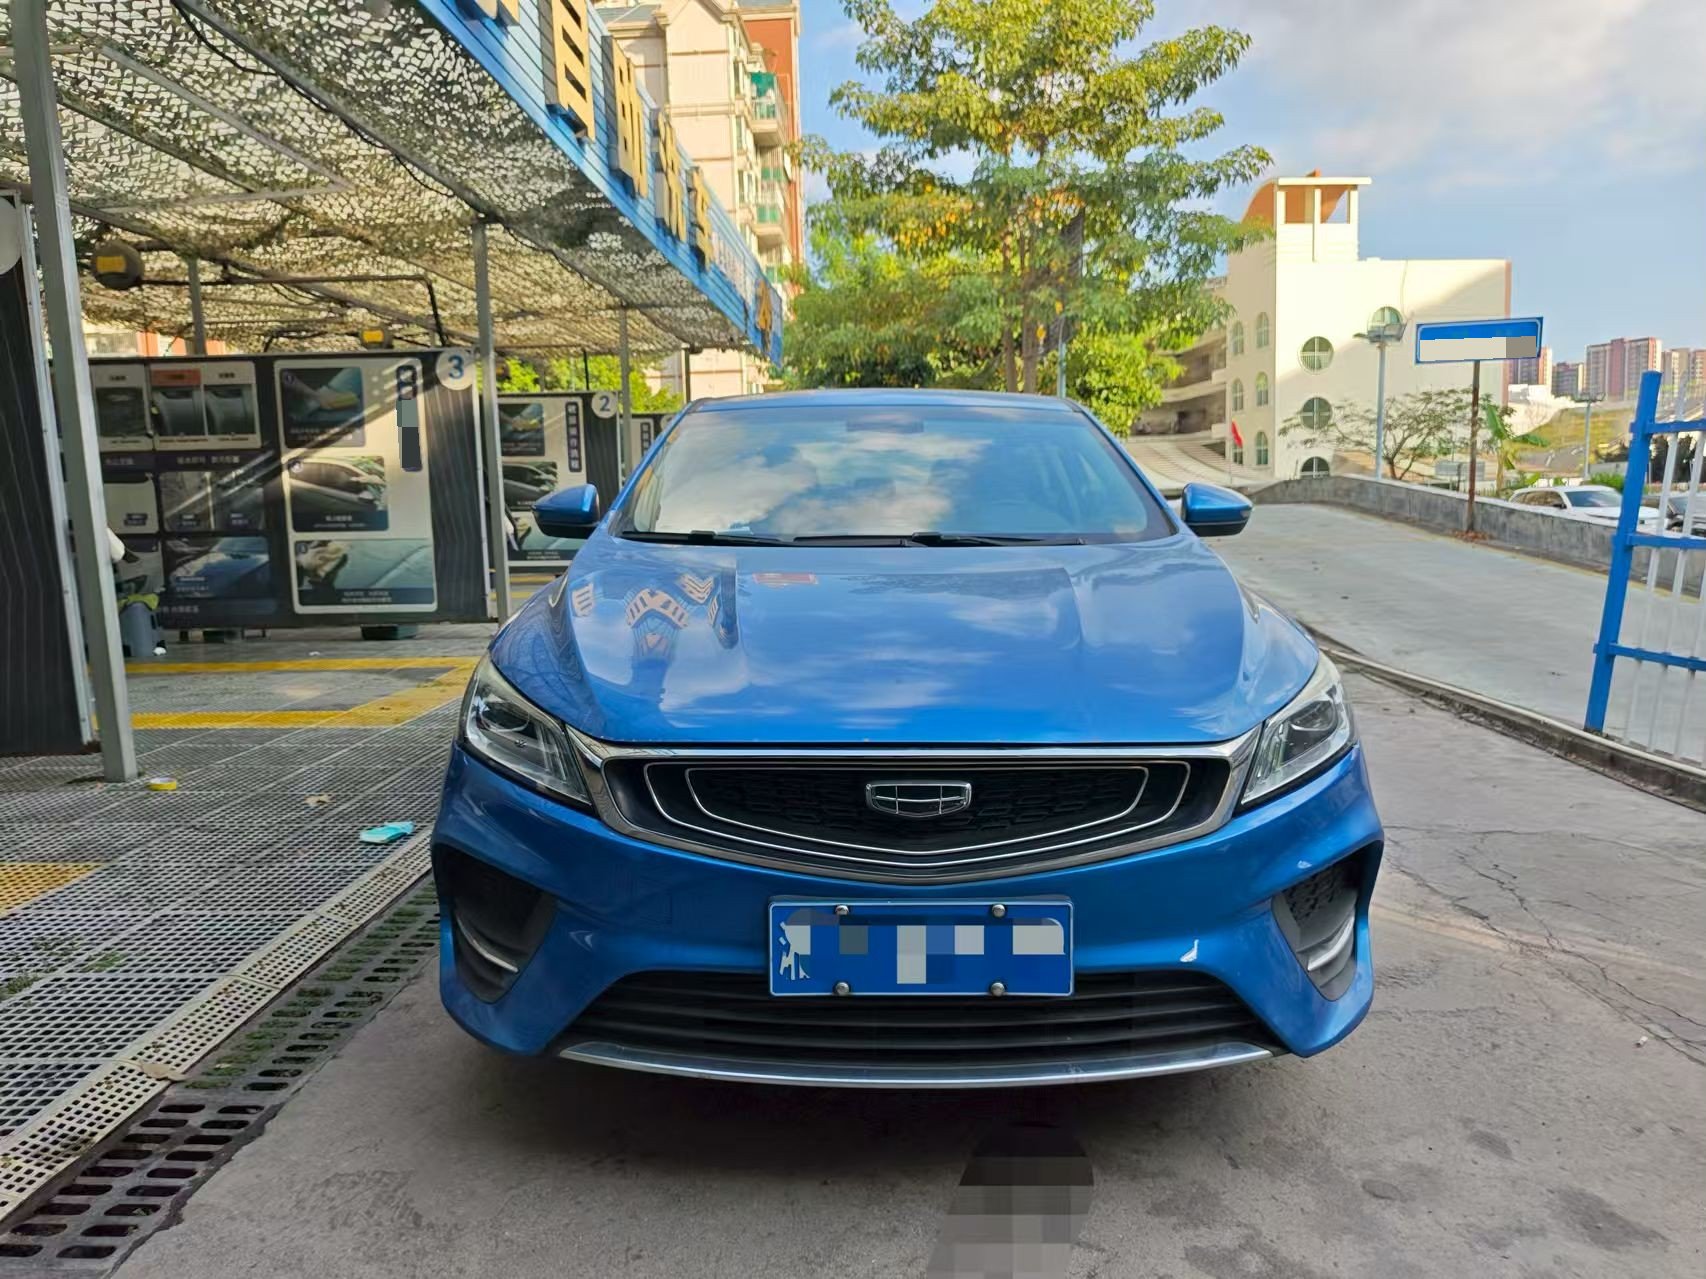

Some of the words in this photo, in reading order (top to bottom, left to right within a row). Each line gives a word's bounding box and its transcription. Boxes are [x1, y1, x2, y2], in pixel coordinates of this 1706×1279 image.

[474, 0, 714, 271] 自助洗车
[447, 354, 465, 379] 3
[599, 395, 611, 412] 2
